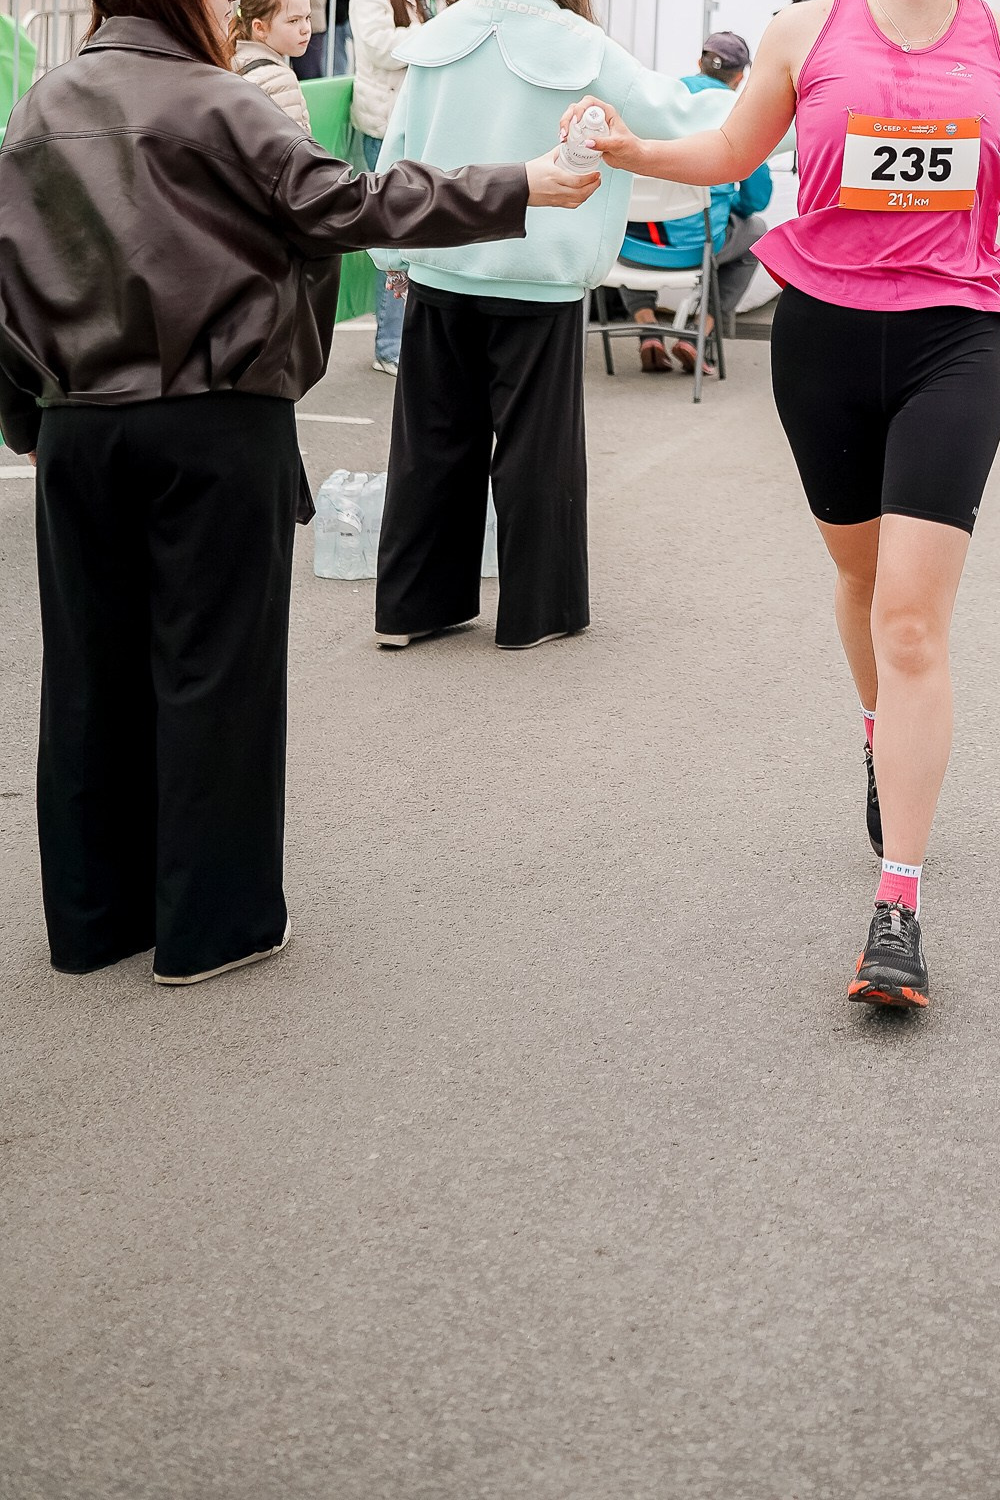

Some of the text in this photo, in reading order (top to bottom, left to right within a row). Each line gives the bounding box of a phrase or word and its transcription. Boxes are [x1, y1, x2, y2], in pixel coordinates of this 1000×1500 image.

[883, 124, 901, 132] СБЕР
[871, 146, 953, 182] 235
[888, 193, 930, 209] 21,1 км
